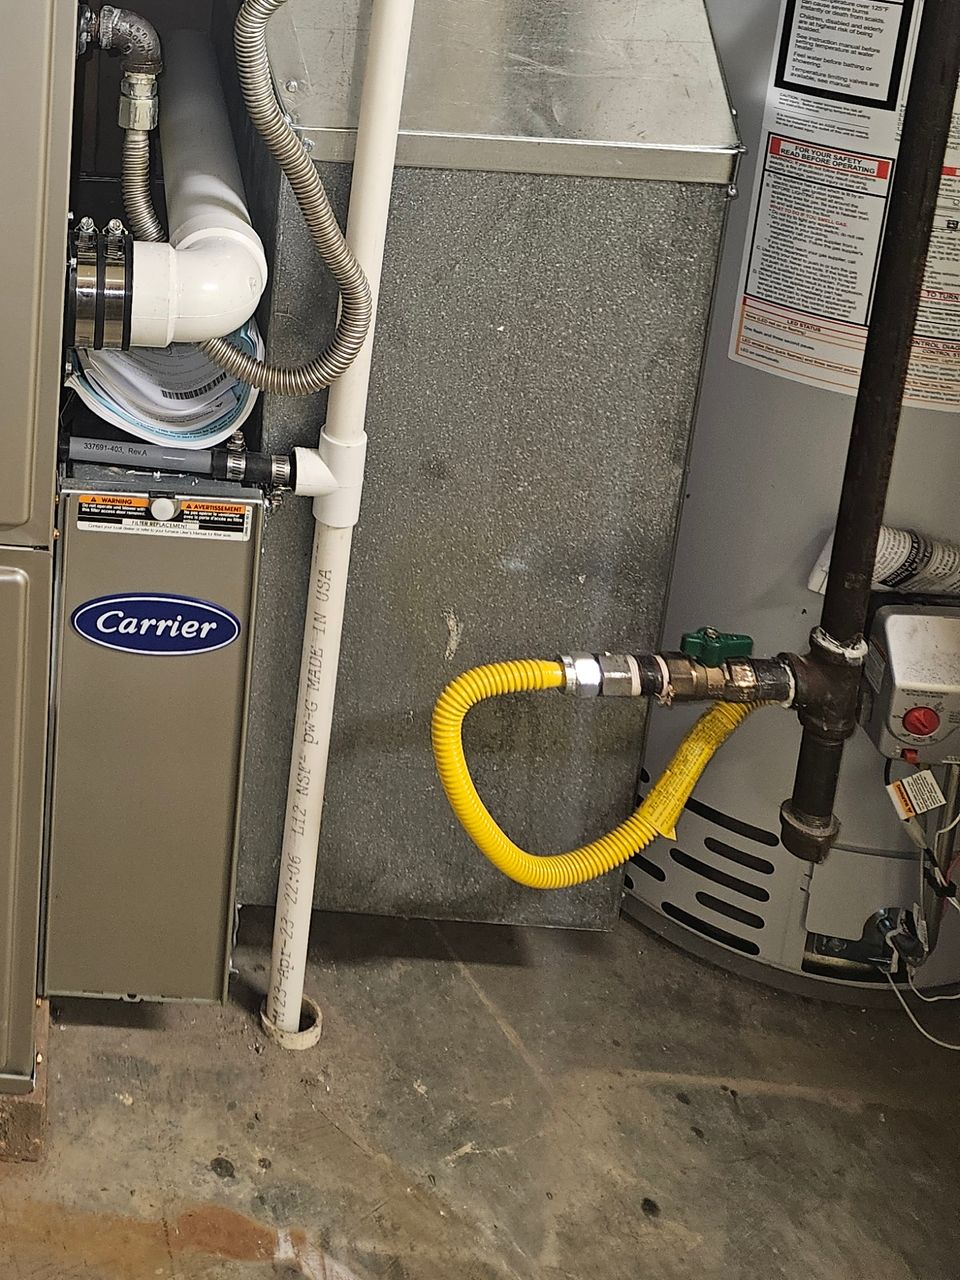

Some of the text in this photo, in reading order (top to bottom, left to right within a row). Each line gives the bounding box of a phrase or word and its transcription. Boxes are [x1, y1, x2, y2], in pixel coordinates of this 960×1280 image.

[855, 1, 869, 9] over
[780, 148, 875, 175] READ BEFORE OPERATING
[794, 145, 862, 165] FOR YOUR SAFETY
[800, 322, 821, 332] STATUS
[193, 503, 241, 512] AVERTISSEMENT
[316, 569, 332, 601] USA
[96, 610, 217, 638] Carrier
[312, 613, 327, 634] IN
[306, 648, 324, 690] MADE
